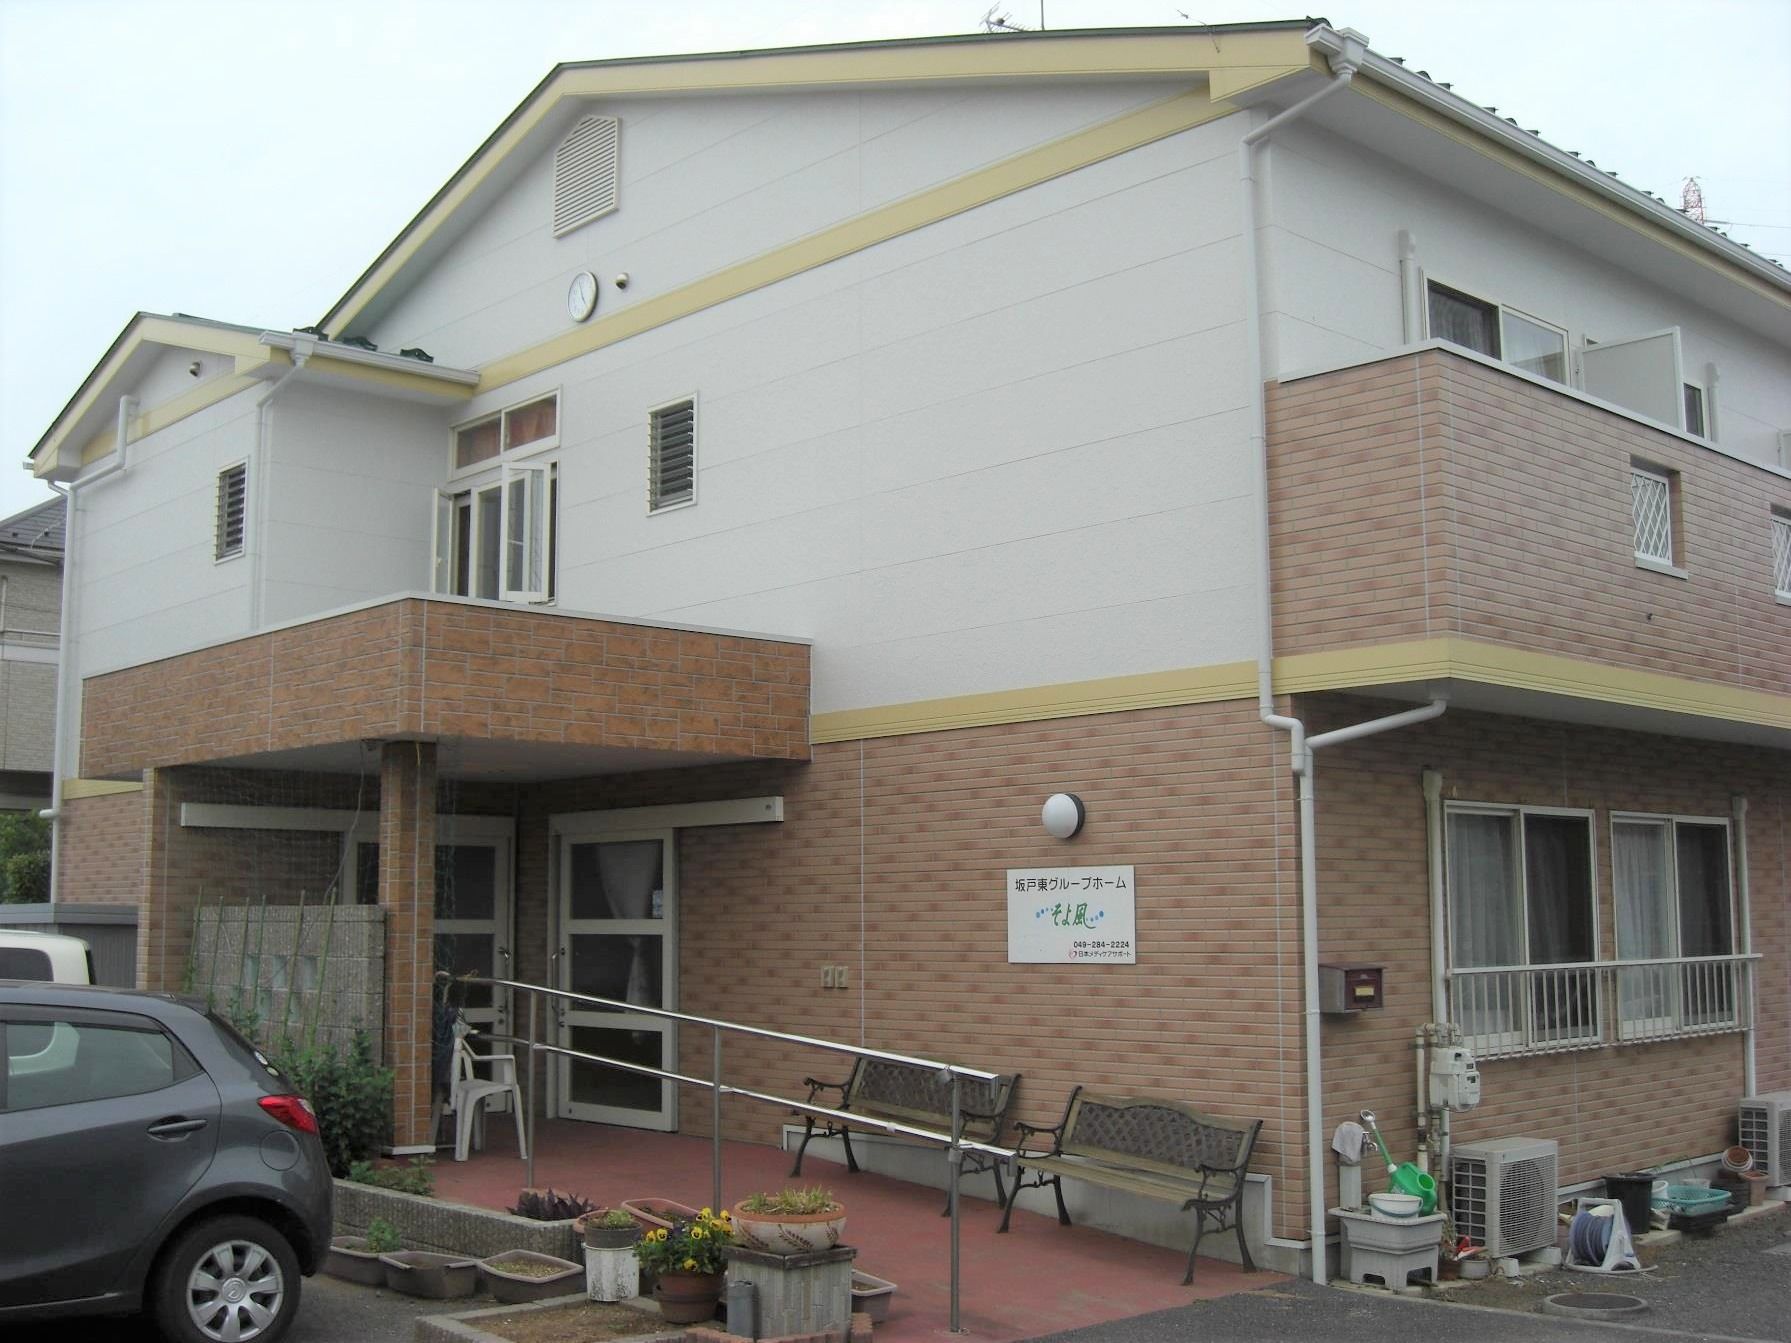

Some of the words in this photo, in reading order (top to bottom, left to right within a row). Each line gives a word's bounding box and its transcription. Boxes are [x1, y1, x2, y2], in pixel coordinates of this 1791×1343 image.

[1015, 876, 1127, 892] 坂戸東グループホーム
[1051, 902, 1096, 930] そよ風
[1073, 941, 1130, 949] 049-284-2224
